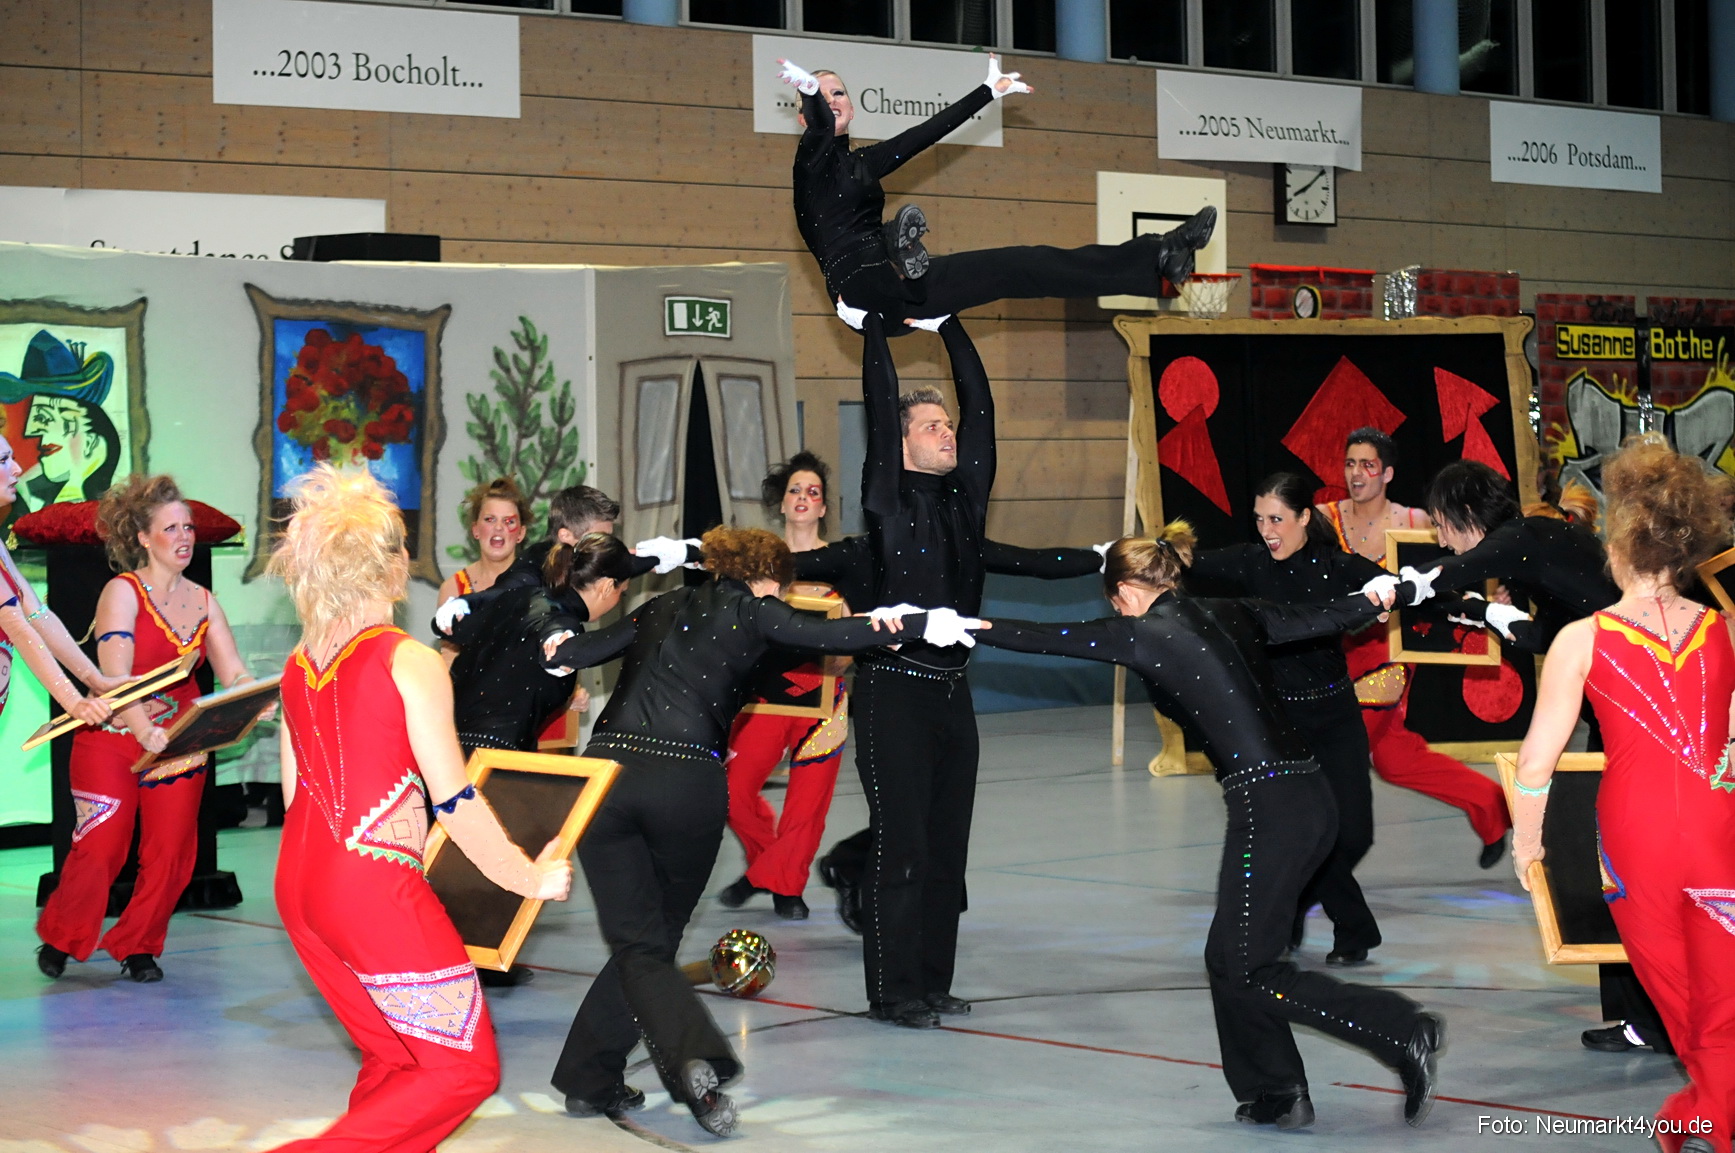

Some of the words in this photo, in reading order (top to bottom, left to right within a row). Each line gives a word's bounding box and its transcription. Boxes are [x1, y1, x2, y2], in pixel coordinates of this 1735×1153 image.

[252, 49, 342, 80] ...2003
[351, 52, 484, 88] Bocholt...
[1179, 114, 1242, 138] ...2005
[1244, 116, 1350, 146] Neumarkt...
[1507, 140, 1558, 165] ...2006
[1567, 142, 1647, 171] Potsdam...
[1556, 325, 1634, 357] Susanne
[1650, 327, 1713, 360] Bothe
